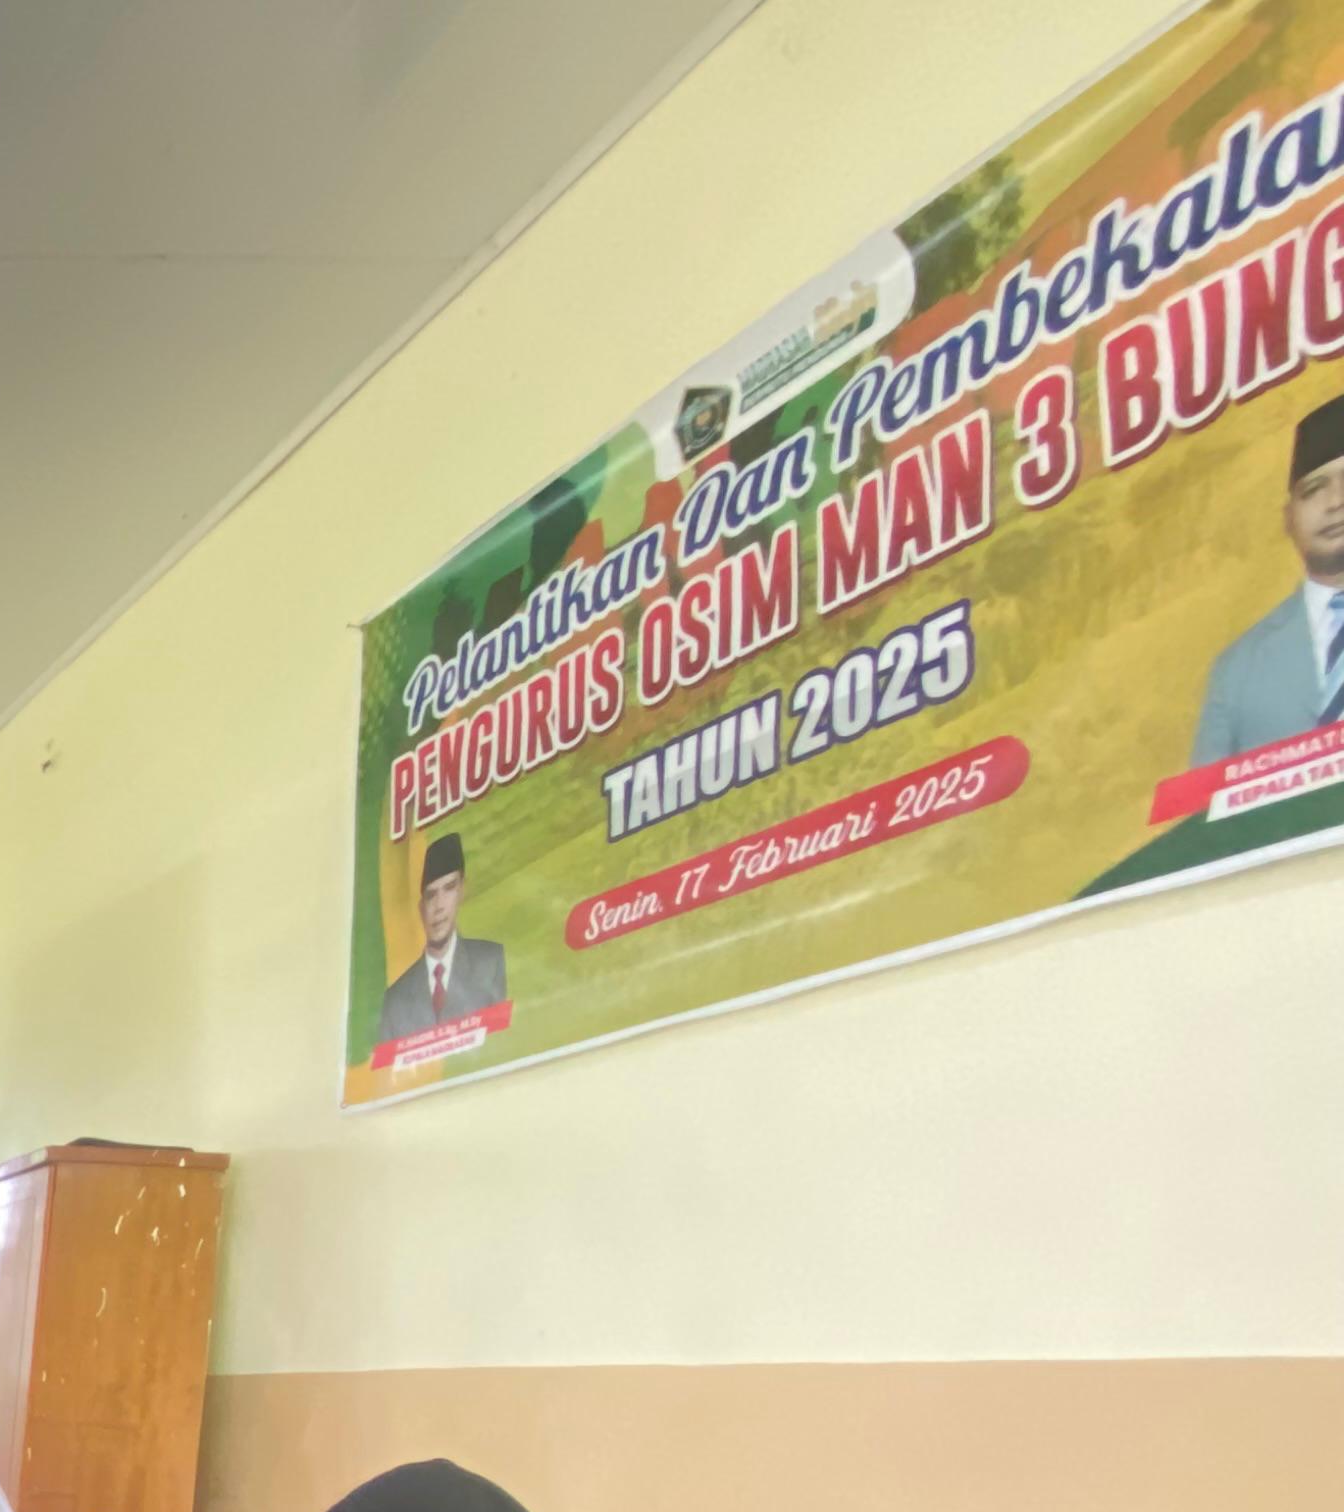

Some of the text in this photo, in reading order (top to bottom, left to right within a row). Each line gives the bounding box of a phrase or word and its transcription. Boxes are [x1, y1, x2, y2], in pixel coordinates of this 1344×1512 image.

[404, 524, 666, 735] Pelantikan
[675, 427, 815, 563] Dan
[825, 81, 1344, 474] Pembekala
[390, 628, 626, 842] PENGURUS
[639, 522, 798, 705] OSIM
[816, 407, 993, 616] MAN
[1013, 364, 1080, 509] 3
[600, 597, 974, 843] TAHUN 2025
[675, 863, 710, 907] 17
[718, 801, 878, 893] Februari
[888, 755, 994, 828] 2025
[1224, 729, 1336, 783] RACHMAT
